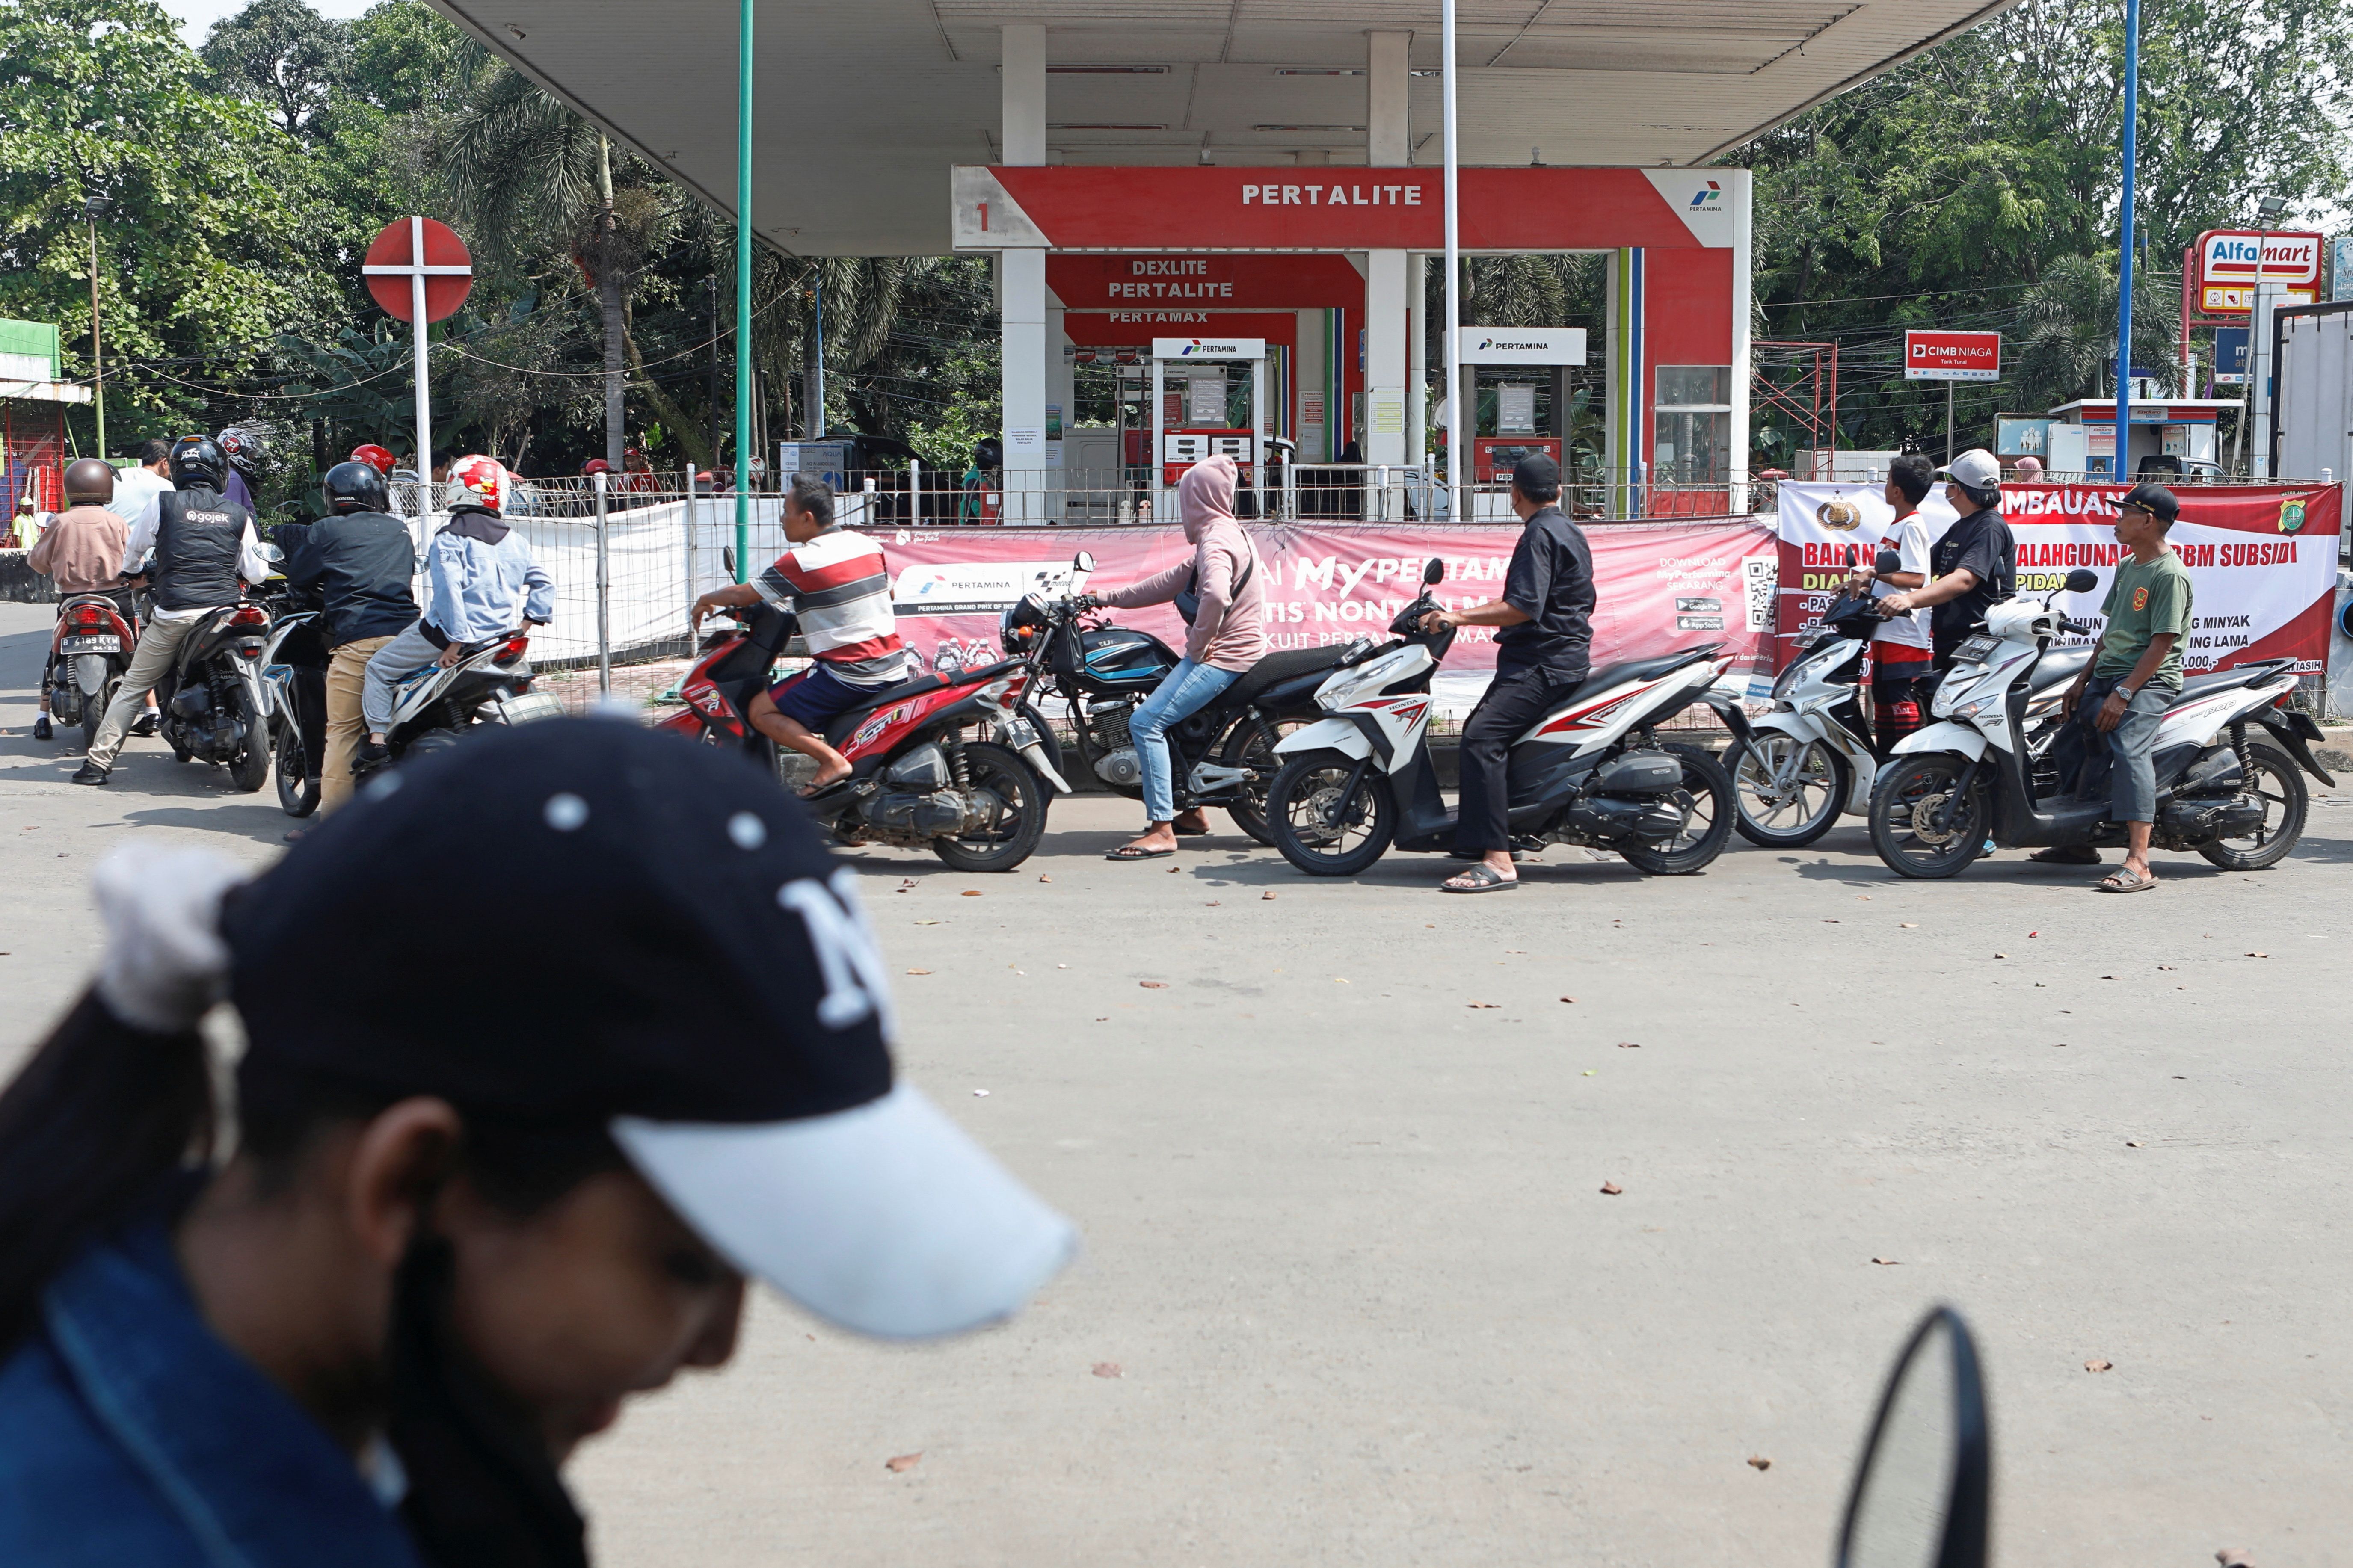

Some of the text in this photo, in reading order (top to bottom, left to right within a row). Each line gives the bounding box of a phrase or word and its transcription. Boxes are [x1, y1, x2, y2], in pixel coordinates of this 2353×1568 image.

[1243, 185, 1422, 205] PERTALITE
[977, 203, 988, 231] 1
[2213, 241, 2312, 262] Alfamart
[1133, 260, 1207, 275] DEXLITE
[1109, 283, 1233, 298] PERTALITE
[1110, 312, 1208, 323] PERTAMAX
[1928, 346, 1992, 357] CIMB NIAGA
[197, 513, 229, 524] gojek
[2220, 541, 2297, 567] SUBSIDI
[1660, 558, 1726, 567] DOWNLOAD
[1657, 569, 1731, 580] MyPertamina
[1667, 581, 1724, 591] SEKARANG
[1689, 603, 1707, 611] Google
[2203, 615, 2251, 629] MINYAK
[1265, 633, 1310, 649] KUIT
[2214, 635, 2249, 647] LAMA
[1389, 699, 1418, 711] HONDA
[2203, 700, 2237, 718] pop
[1395, 708, 1420, 723] FI
